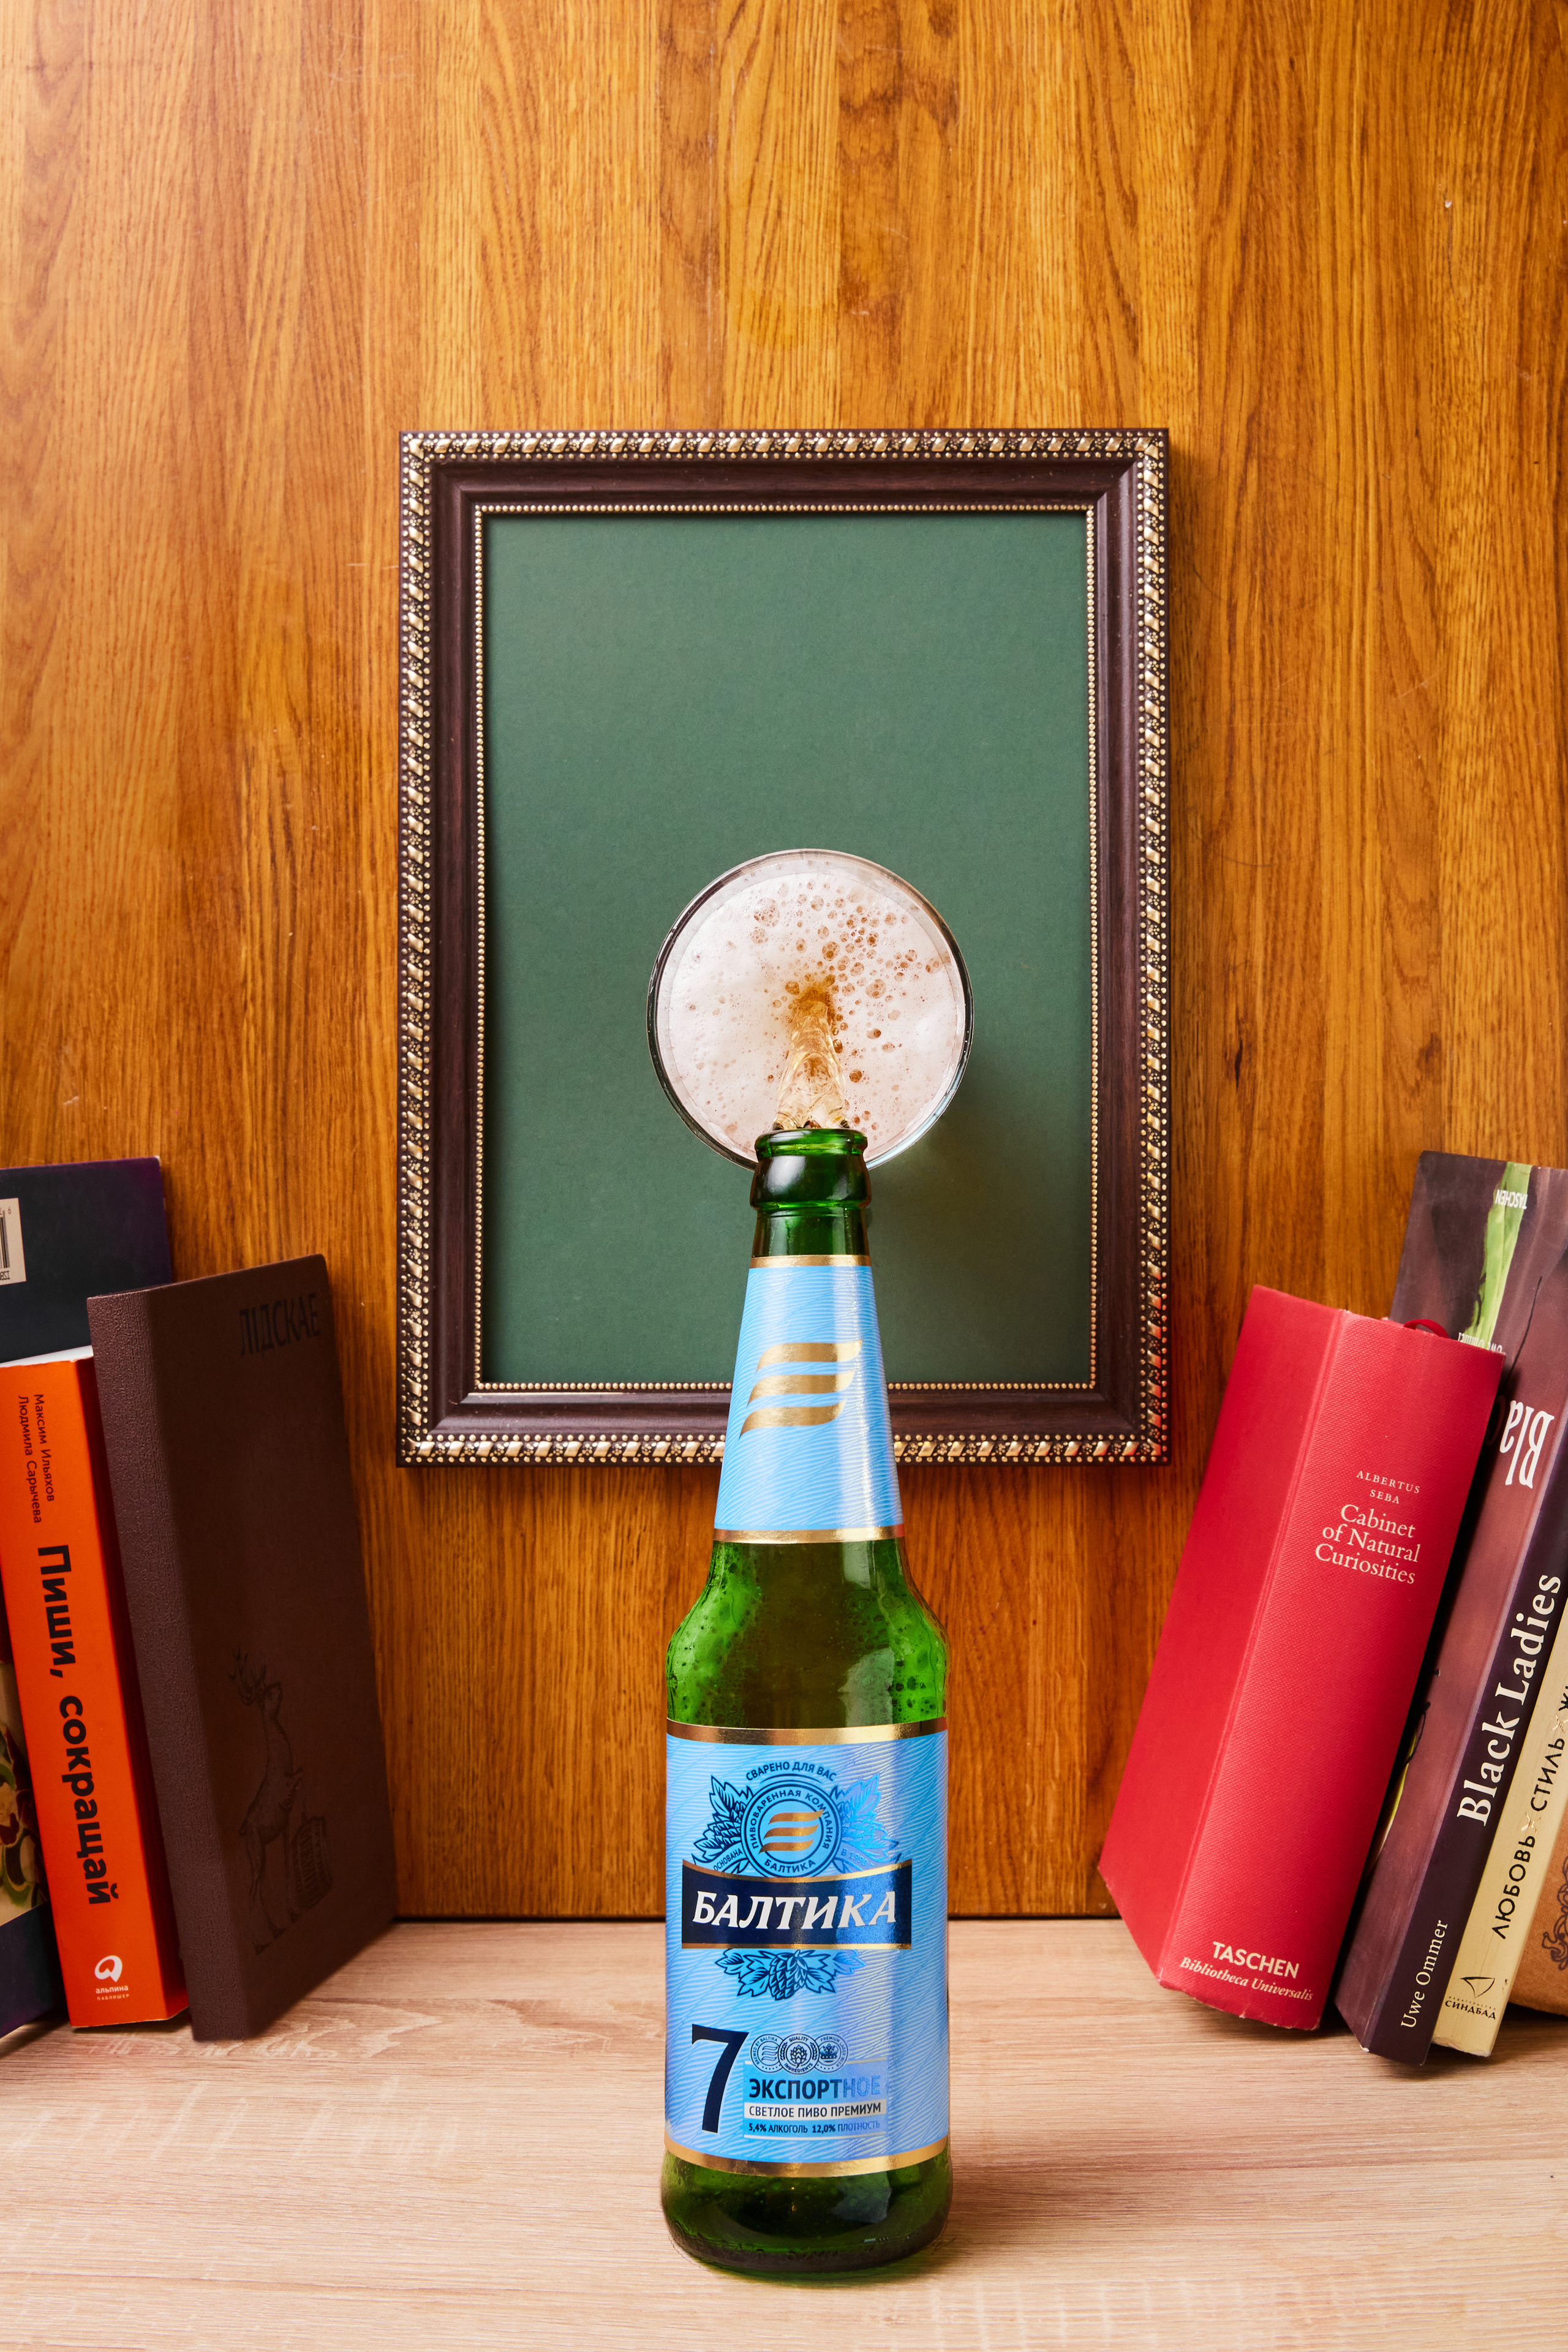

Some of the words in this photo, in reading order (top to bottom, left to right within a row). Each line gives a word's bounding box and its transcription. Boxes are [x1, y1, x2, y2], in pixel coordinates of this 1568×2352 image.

[1495, 1189, 1528, 1210] TASCHEN
[18, 1395, 33, 1456] Людмила
[26, 1460, 42, 1523] Сарычева
[34, 1394, 47, 1444] Максим
[41, 1449, 55, 1502] Ильяхов
[1356, 1470, 1420, 1494] ALBERTUS
[1370, 1489, 1400, 1504] SEBA
[1341, 1504, 1415, 1538] Cabinet
[1322, 1523, 1348, 1542] of
[1348, 1528, 1420, 1562] Natural
[1315, 1544, 1415, 1584] Curiosities
[1457, 1711, 1520, 1827] Black
[1495, 1574, 1561, 1705] Ladies
[37, 1544, 76, 1678] Пиши,
[59, 1695, 119, 1904] сокращай
[746, 1762, 790, 1781] СВАРЕНО
[792, 1762, 815, 1773] ДЛЯ
[816, 1766, 837, 1781] ВАС
[750, 1789, 801, 1849] ПИВОВАРЕННАЯ
[805, 1793, 833, 1850] КОМПАНИЯ
[1492, 1835, 1536, 1939] ЛЮБОВЬ
[1531, 1738, 1565, 1812] СТИЛЬ
[714, 1848, 743, 1871] ОСНОВАНА
[764, 1859, 816, 1873] БАЛТИКА
[692, 1891, 896, 1929] БАЛТИКА
[1213, 1941, 1299, 1979] TASCHEN
[1401, 1991, 1425, 2028] Uwe
[1415, 1920, 1448, 1986] Ommer
[96, 1985, 129, 1994] альпина
[1180, 1957, 1249, 1987] Bibliotheca
[1251, 1978, 1314, 2000] Universalis
[1445, 2000, 1496, 2020] СИНДБАД
[692, 2024, 749, 2133] 7
[784, 2063, 813, 2073] INGREDIENTS
[749, 2075, 881, 2099] ЭКСПОРТНОЕ
[748, 2123, 766, 2133] 5,4%
[769, 2124, 808, 2133] АЛКОГОЛЬ
[812, 2124, 835, 2133] 12,0%
[838, 2120, 880, 2132] ПЛОТНОСТЬ
[749, 2106, 794, 2117] СВЕТЛОЕ
[798, 2107, 827, 2117] ПИВО
[831, 2103, 881, 2116] ПРЕМИУМ
